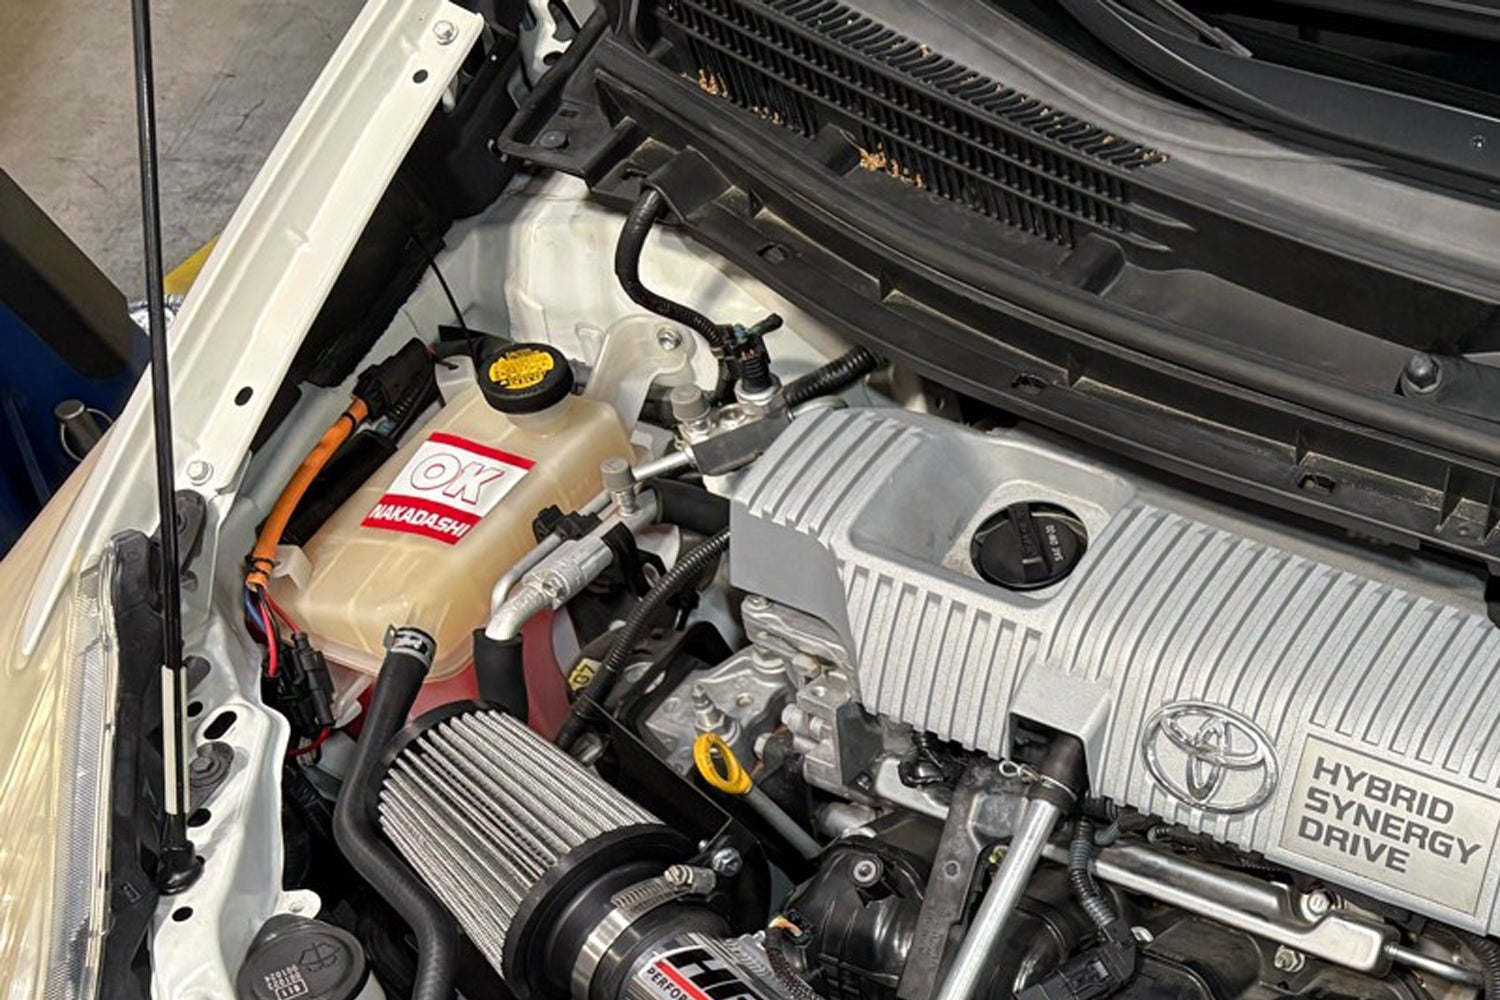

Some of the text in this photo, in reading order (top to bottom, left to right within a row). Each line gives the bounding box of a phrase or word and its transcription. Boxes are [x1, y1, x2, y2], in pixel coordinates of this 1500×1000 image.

[410, 453, 505, 505] OK
[369, 504, 471, 538] NAKADASHI
[1313, 756, 1454, 825] HYBRID
[1299, 815, 1411, 873] DRIVE
[1305, 787, 1482, 865] SYNERGY
